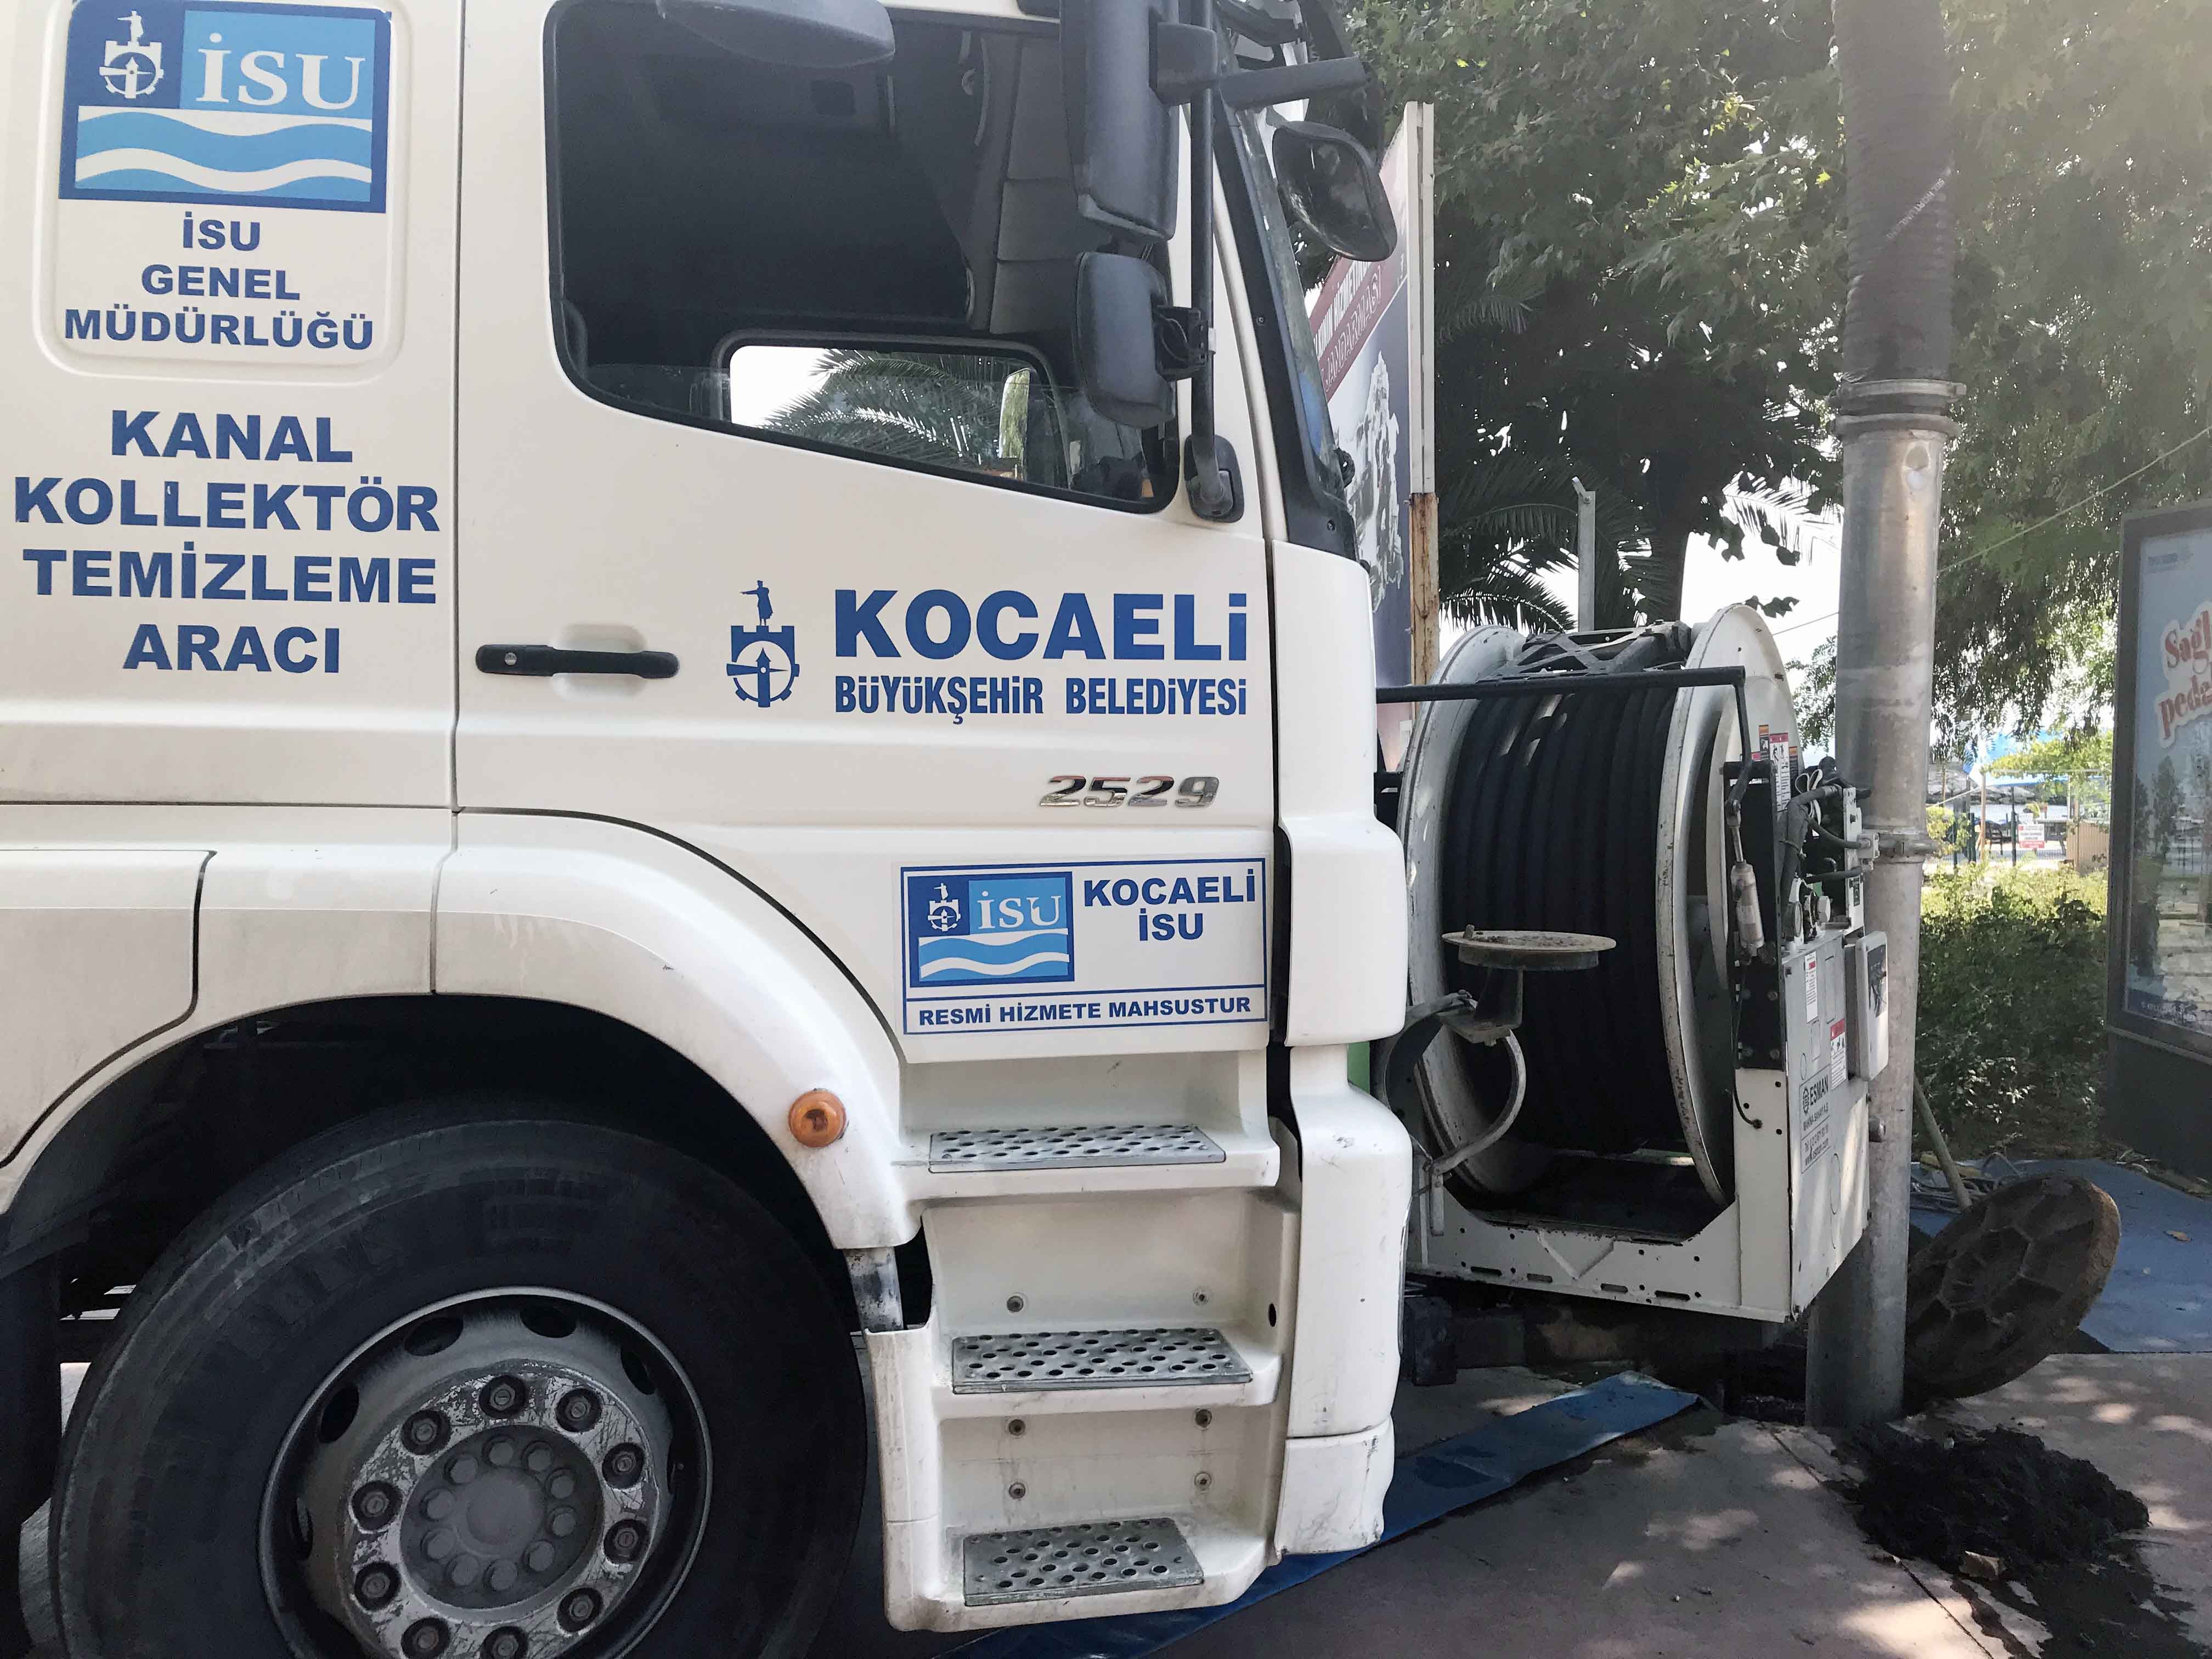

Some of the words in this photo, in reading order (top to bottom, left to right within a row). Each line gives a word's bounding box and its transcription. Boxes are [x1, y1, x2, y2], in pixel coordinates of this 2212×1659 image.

[195, 33, 365, 110] İSU
[183, 211, 261, 251] İSU
[142, 264, 300, 301] GENEL
[65, 303, 373, 351] MÜDÜRLÜĞÜ
[112, 410, 353, 462] KANAL
[15, 476, 440, 533] KOLLEKTÖR
[22, 541, 437, 604] TEMİZLEME
[123, 624, 340, 674] ARACI
[835, 589, 1247, 661] KOCAELİ
[2165, 610, 2212, 675] Sağl
[836, 675, 1043, 725] BÜYÜKŞEHİR
[1066, 678, 1247, 715] BELEDİYESİ
[2159, 665, 2212, 738] peda
[1040, 775, 1220, 808] 2529
[977, 890, 1062, 929] İSU
[1084, 868, 1255, 907] KOCAELİ
[1138, 908, 1203, 941] İSU
[919, 1003, 991, 1026] RESMİ
[1000, 1002, 1101, 1023] HİZMETE
[1109, 997, 1251, 1019] MAHSUSTUR
[1810, 1075, 1829, 1106] ESMAN
